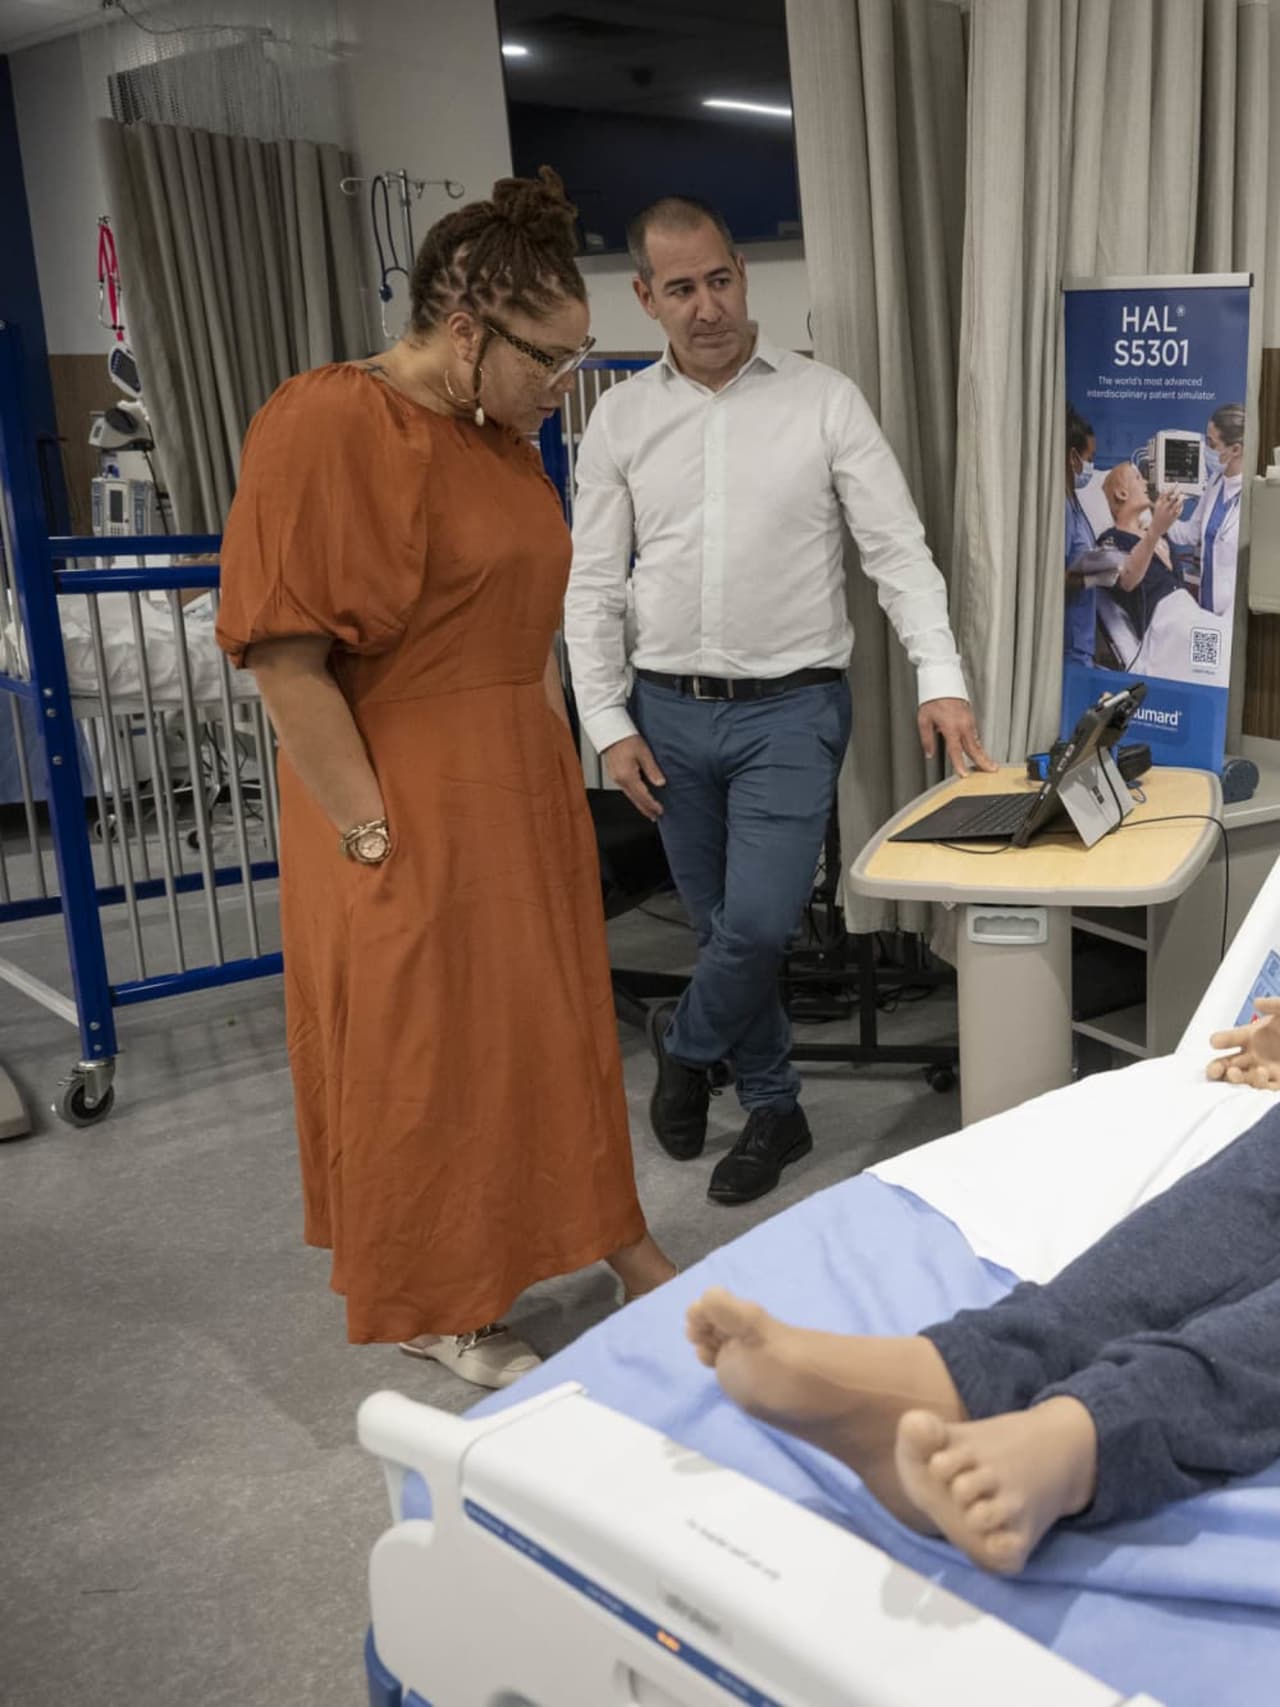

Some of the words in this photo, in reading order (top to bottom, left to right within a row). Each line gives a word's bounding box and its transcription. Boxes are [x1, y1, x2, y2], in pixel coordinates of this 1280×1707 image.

[1114, 340, 1189, 366] S5301
[1098, 376, 1112, 386] The
[1114, 376, 1142, 386] world's
[1144, 377, 1162, 387] most
[1164, 377, 1203, 387] advanced
[1149, 391, 1176, 400] patient
[1133, 708, 1179, 726] umard
